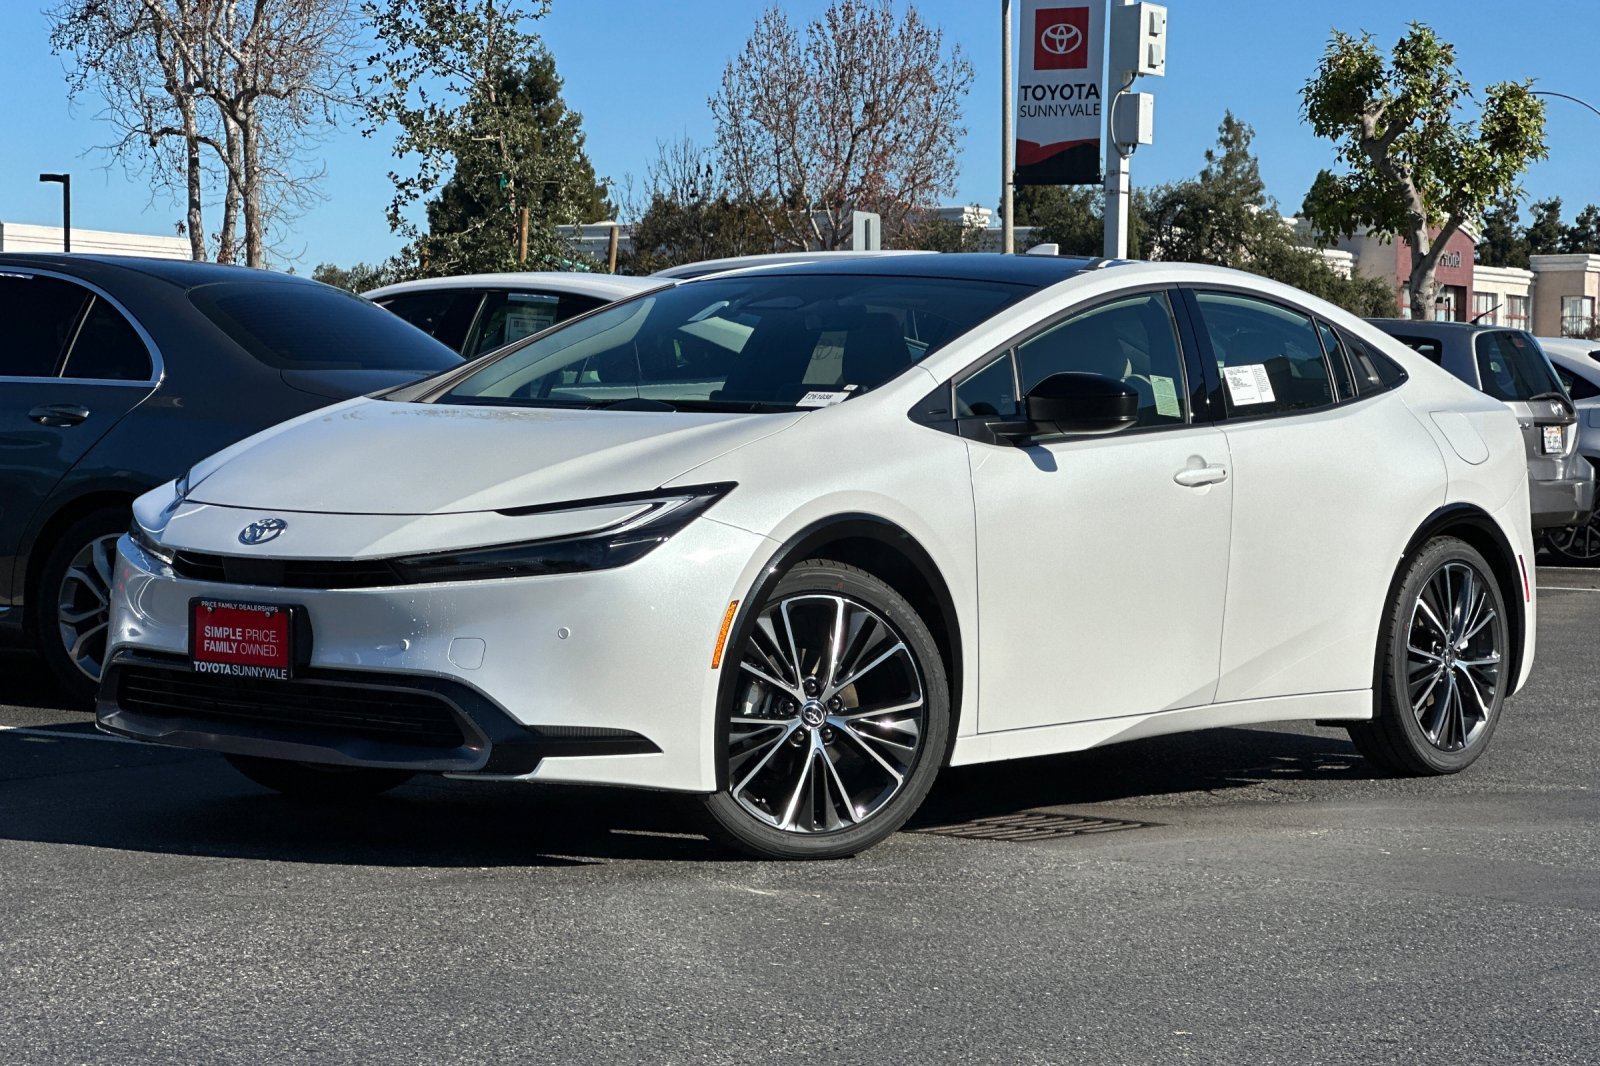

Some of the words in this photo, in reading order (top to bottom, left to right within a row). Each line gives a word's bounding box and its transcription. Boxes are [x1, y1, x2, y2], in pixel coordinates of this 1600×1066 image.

[1020, 83, 1100, 101] TOYOTA
[1020, 103, 1101, 117] SUNNYVALE
[201, 600, 217, 608] PRICE
[218, 602, 238, 610] FAMILY
[238, 604, 279, 613] DEALERSHIPS
[204, 625, 243, 640] SIMPLE
[245, 628, 279, 643] PRICE.
[204, 639, 238, 653] FAMILY
[239, 642, 279, 657] OWNED.
[194, 660, 231, 675] TOYOTA
[231, 664, 288, 680] SUNNYVALE
